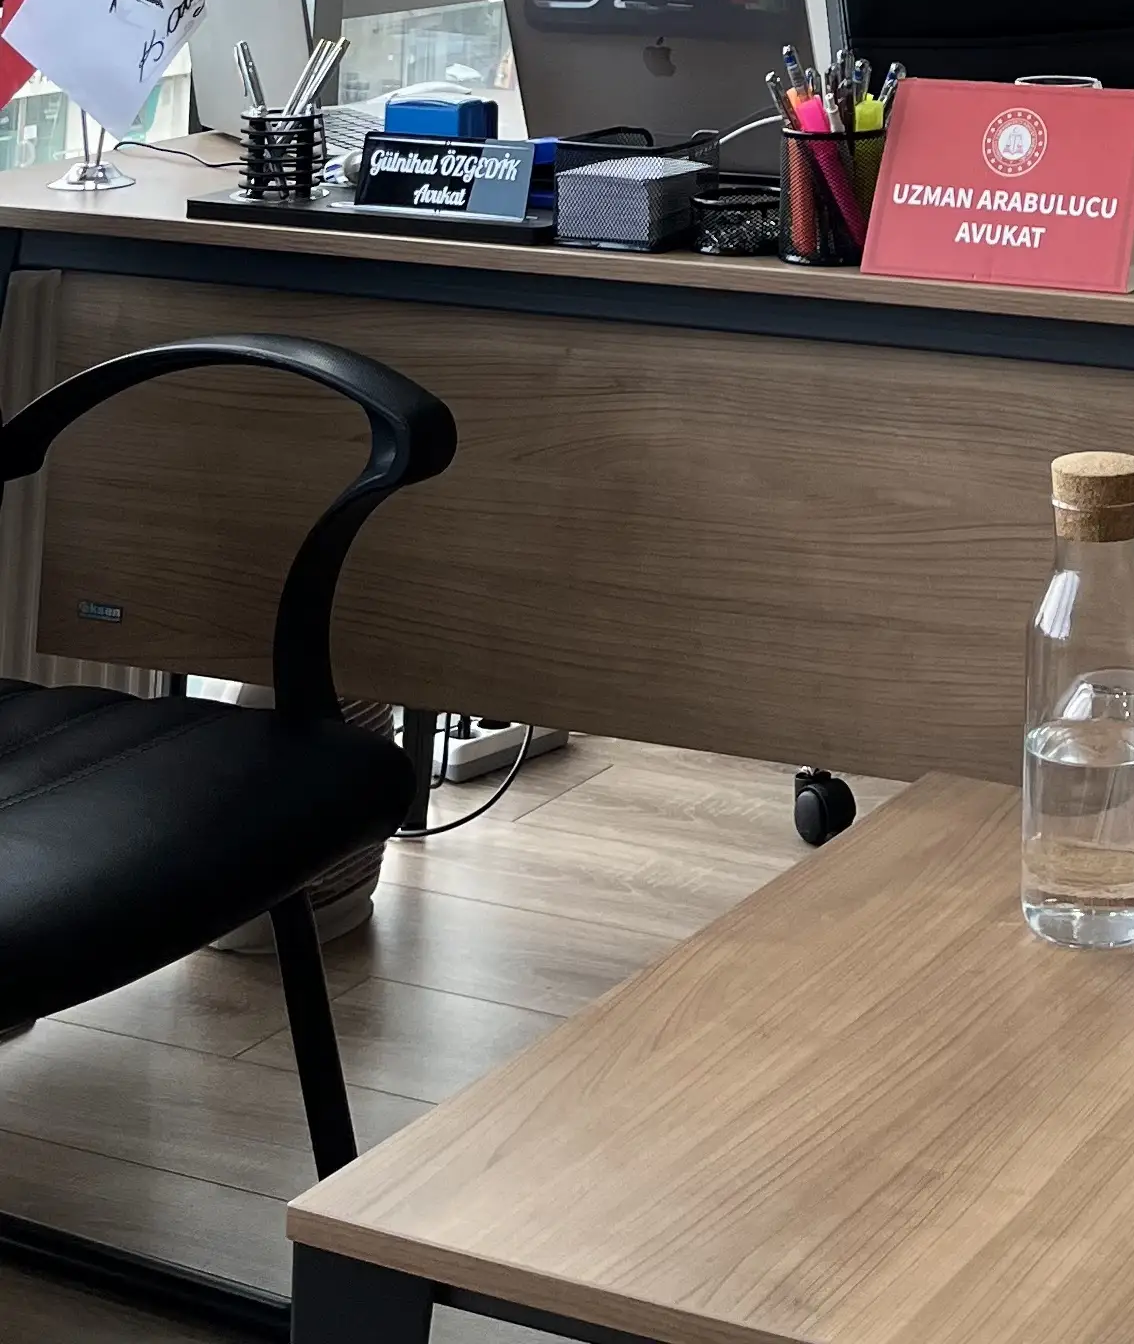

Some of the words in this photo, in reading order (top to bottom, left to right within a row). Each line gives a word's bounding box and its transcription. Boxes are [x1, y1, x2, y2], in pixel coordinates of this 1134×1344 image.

[370, 149, 439, 176] Gülnihal
[440, 149, 522, 183] ÖZGEDİK
[413, 183, 467, 206] Avukat
[892, 183, 973, 210] UZMAN
[976, 189, 1118, 219] ARABULUCU
[954, 221, 1046, 248] AVUKAT
